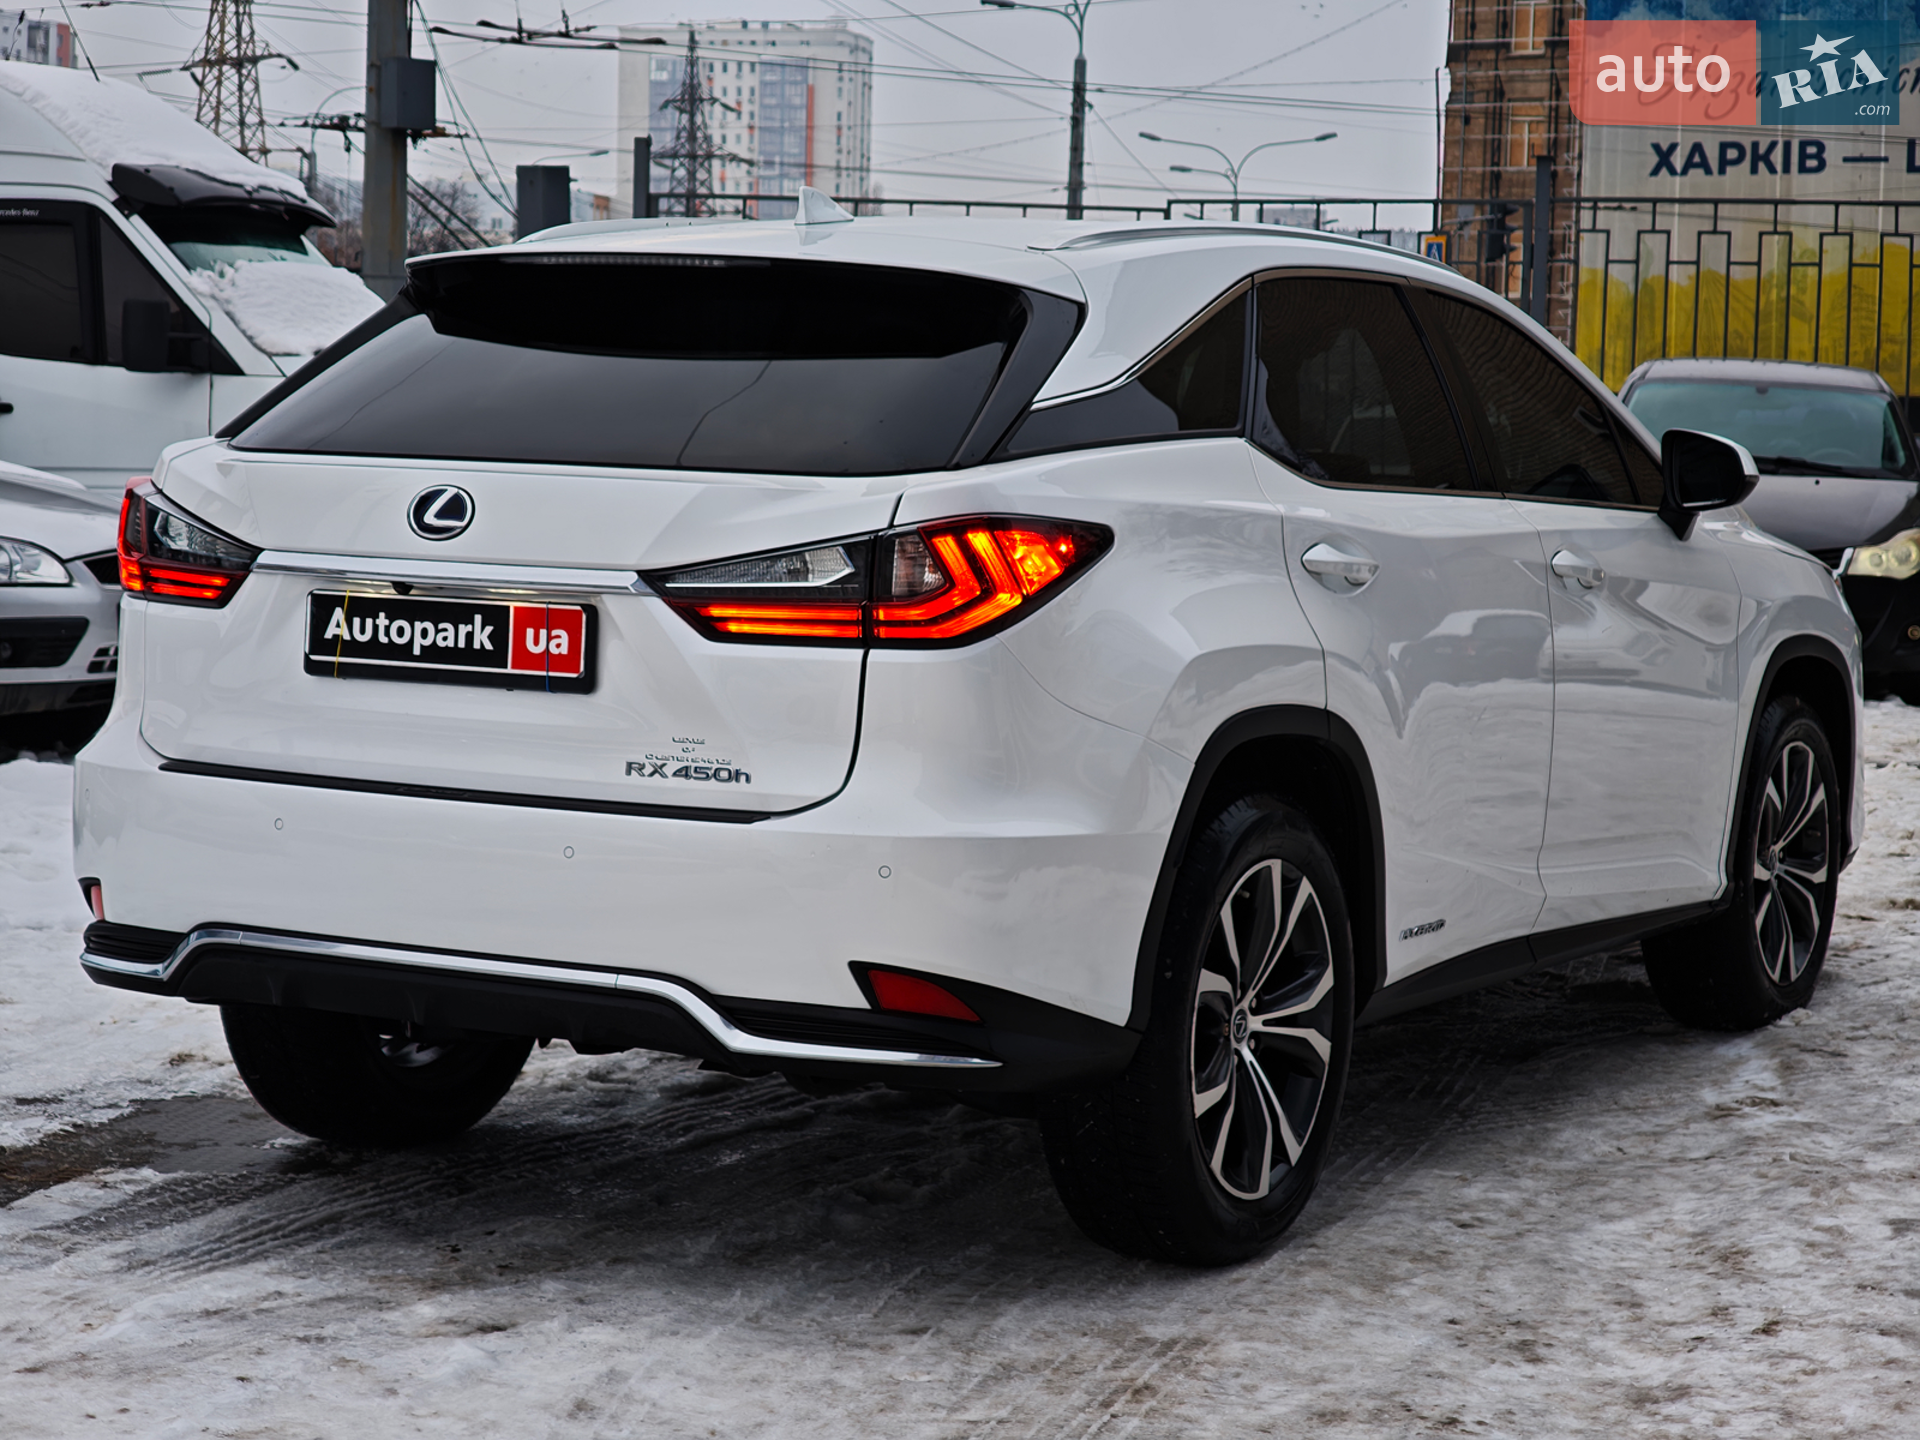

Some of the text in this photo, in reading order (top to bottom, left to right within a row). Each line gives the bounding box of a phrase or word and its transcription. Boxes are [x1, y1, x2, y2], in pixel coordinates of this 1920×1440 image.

[1648, 139, 1828, 178] ХАРКІВ
[323, 606, 570, 656] Autopark ua
[625, 760, 752, 785] RX 450h
